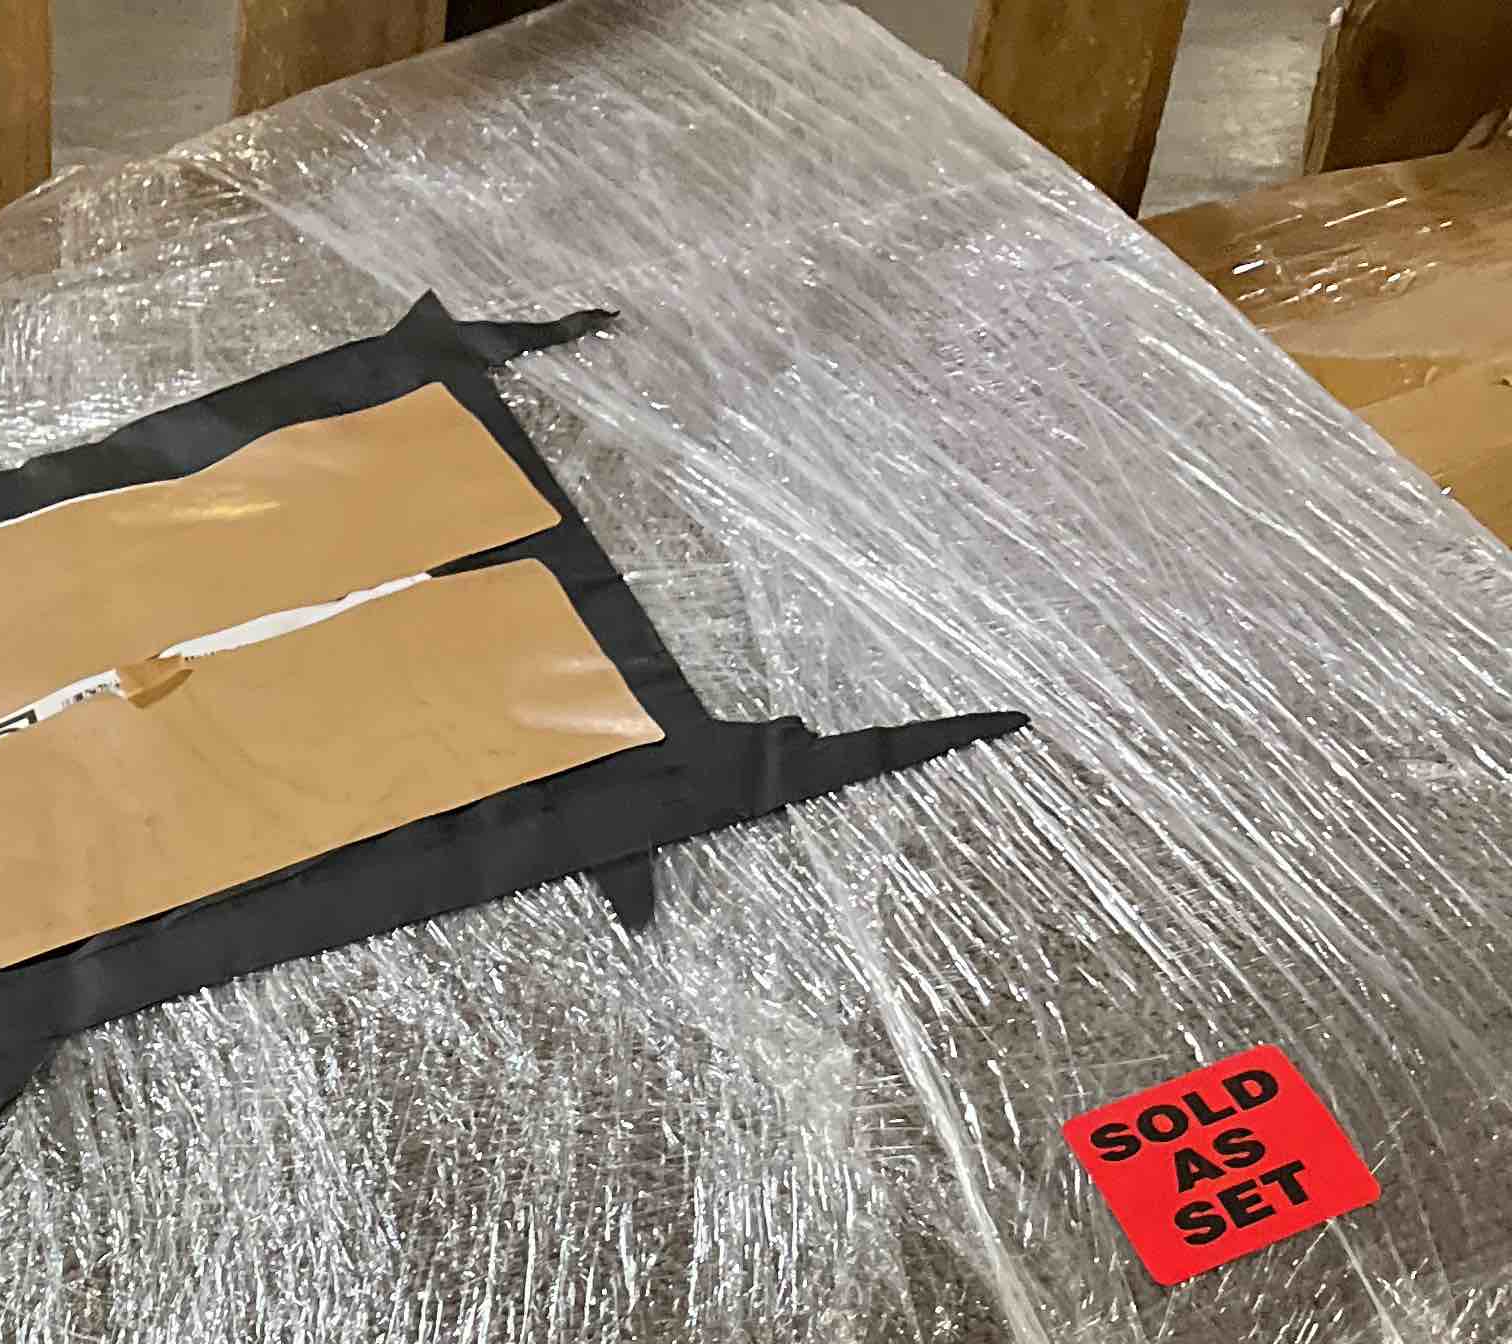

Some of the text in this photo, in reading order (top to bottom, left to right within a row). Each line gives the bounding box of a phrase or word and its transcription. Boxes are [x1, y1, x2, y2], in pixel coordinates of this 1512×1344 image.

[1089, 1068, 1280, 1163] SOLD
[1173, 1126, 1267, 1193] AS
[1173, 1159, 1312, 1246] SET
